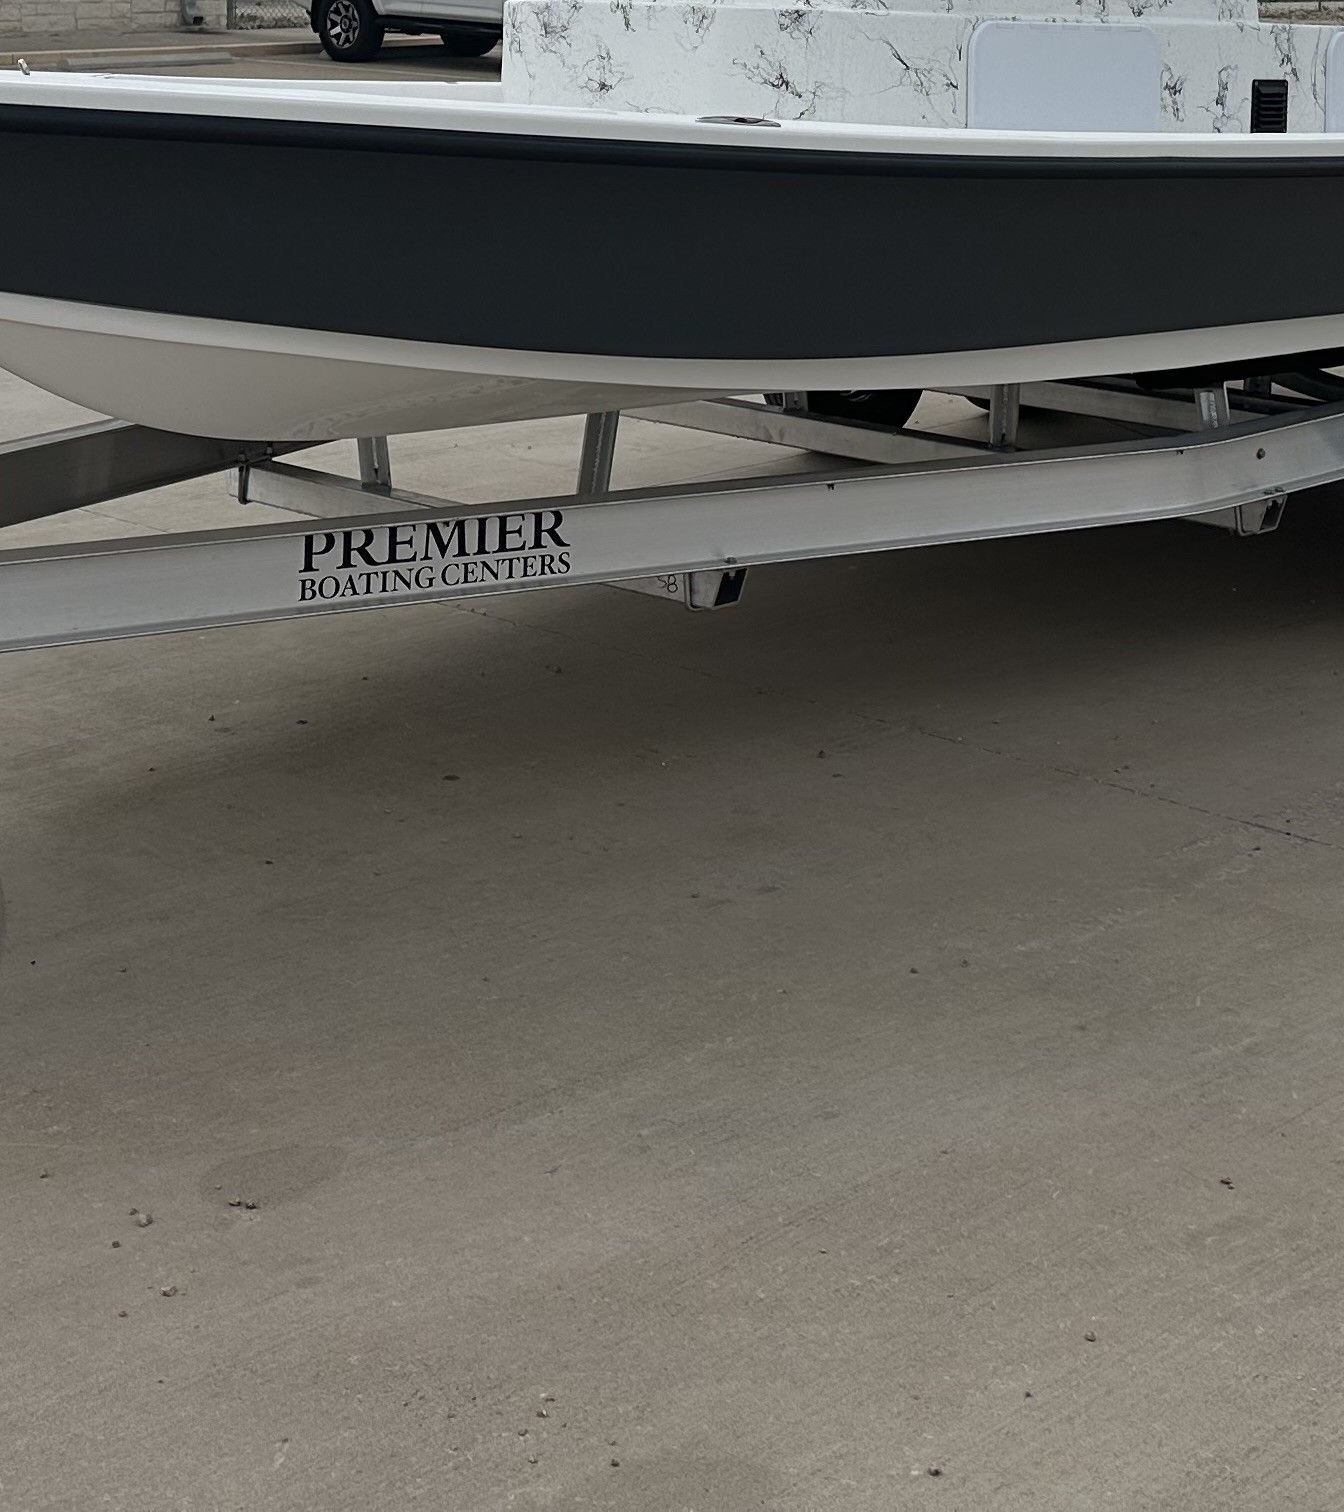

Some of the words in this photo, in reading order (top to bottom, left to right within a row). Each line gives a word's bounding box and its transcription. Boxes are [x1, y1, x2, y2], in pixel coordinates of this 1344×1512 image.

[299, 510, 570, 573] PREMIER
[298, 566, 435, 602] BOATING
[441, 551, 571, 586] CENTERS
